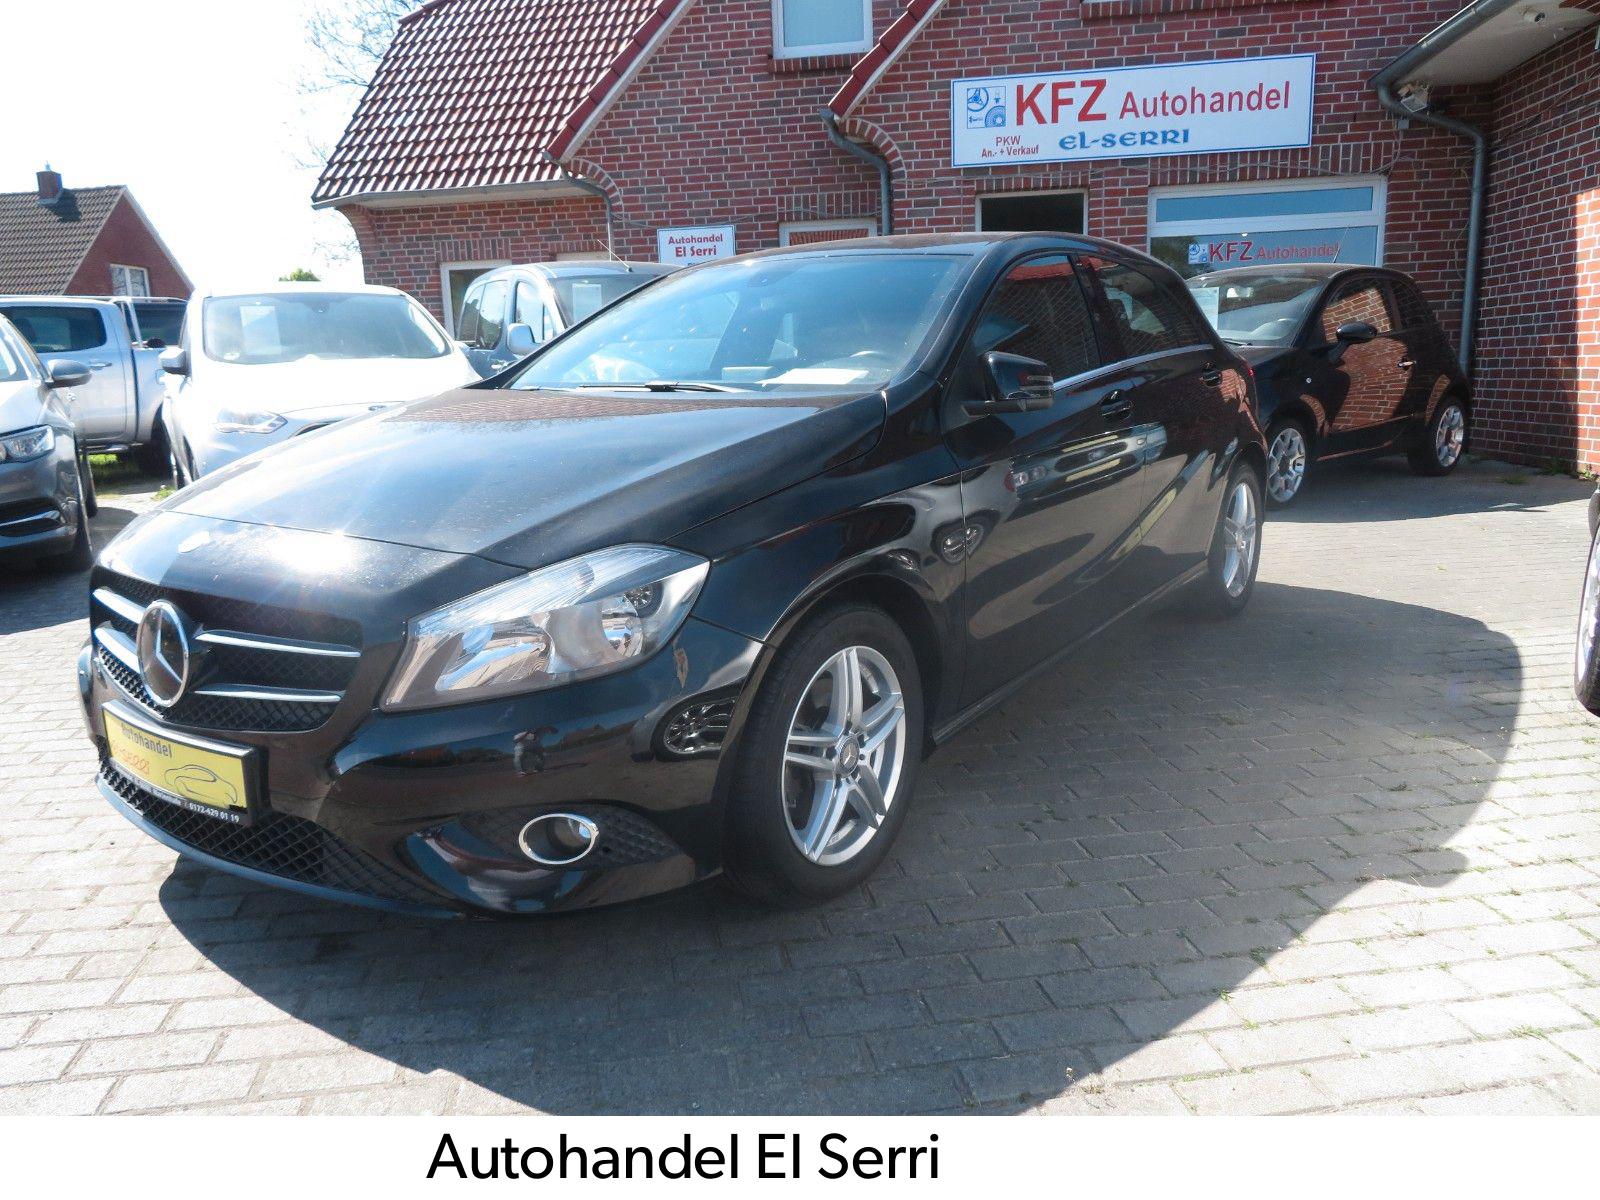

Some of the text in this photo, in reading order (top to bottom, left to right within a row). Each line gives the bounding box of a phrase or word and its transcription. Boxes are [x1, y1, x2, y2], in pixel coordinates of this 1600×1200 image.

[1016, 79, 1290, 126] KFZ Autohandel
[995, 135, 1021, 146] PKW
[1006, 144, 1039, 156] Verkauf
[668, 233, 723, 245] Autohandel
[675, 245, 717, 257] El Serri
[1209, 241, 1340, 262] KFZ Autohandel
[230, 813, 240, 823] 19
